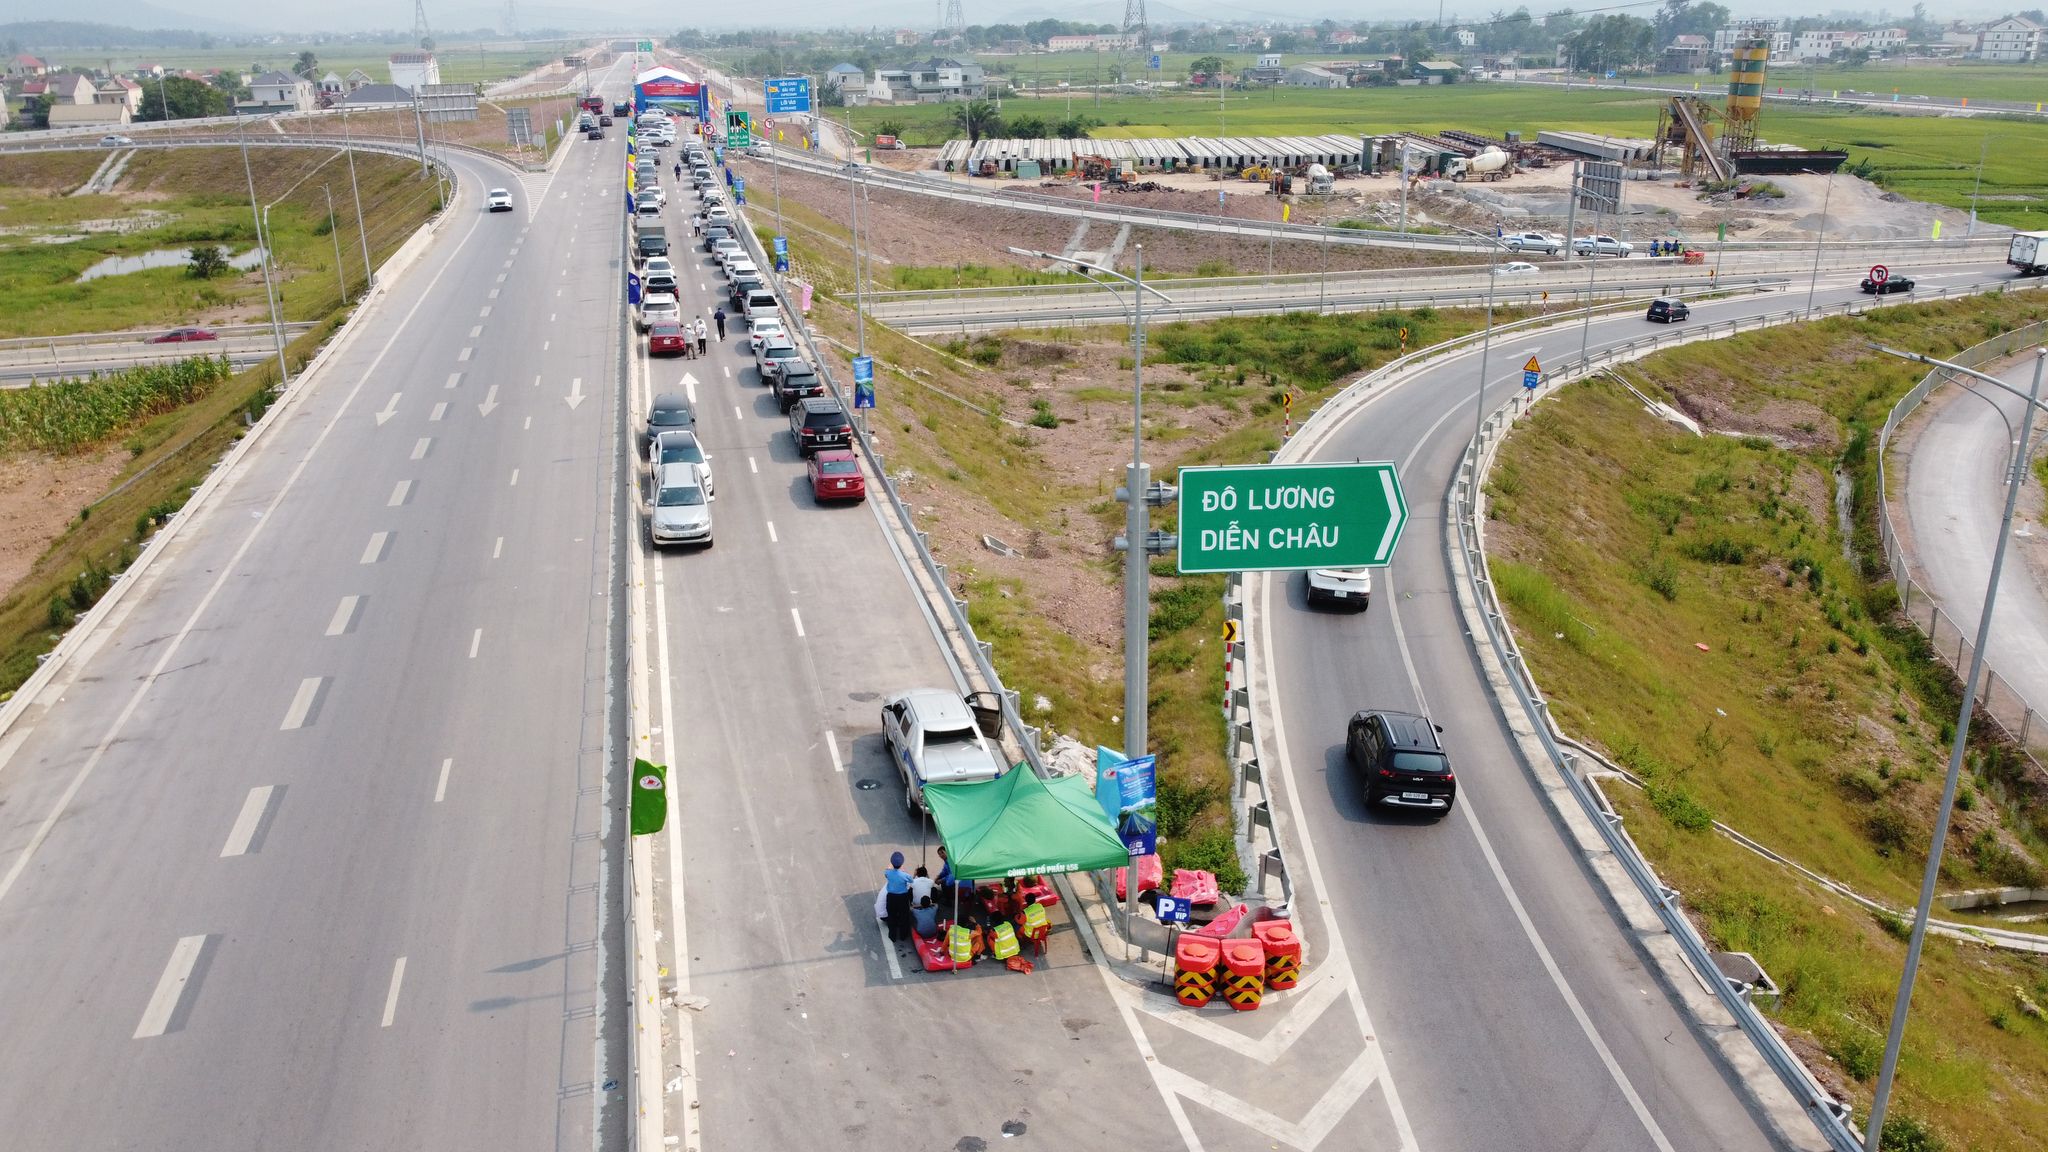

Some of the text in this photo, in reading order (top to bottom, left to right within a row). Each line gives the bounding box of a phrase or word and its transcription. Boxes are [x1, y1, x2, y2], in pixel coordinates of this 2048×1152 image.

[1201, 485, 1335, 512] ĐÔ LƯƠNG
[1201, 520, 1339, 551] DIỄN CHÂU
[1007, 867, 1026, 877] CÔNG
[1027, 867, 1035, 875] TY
[1158, 898, 1175, 917] P
[1175, 911, 1187, 920] VIP
